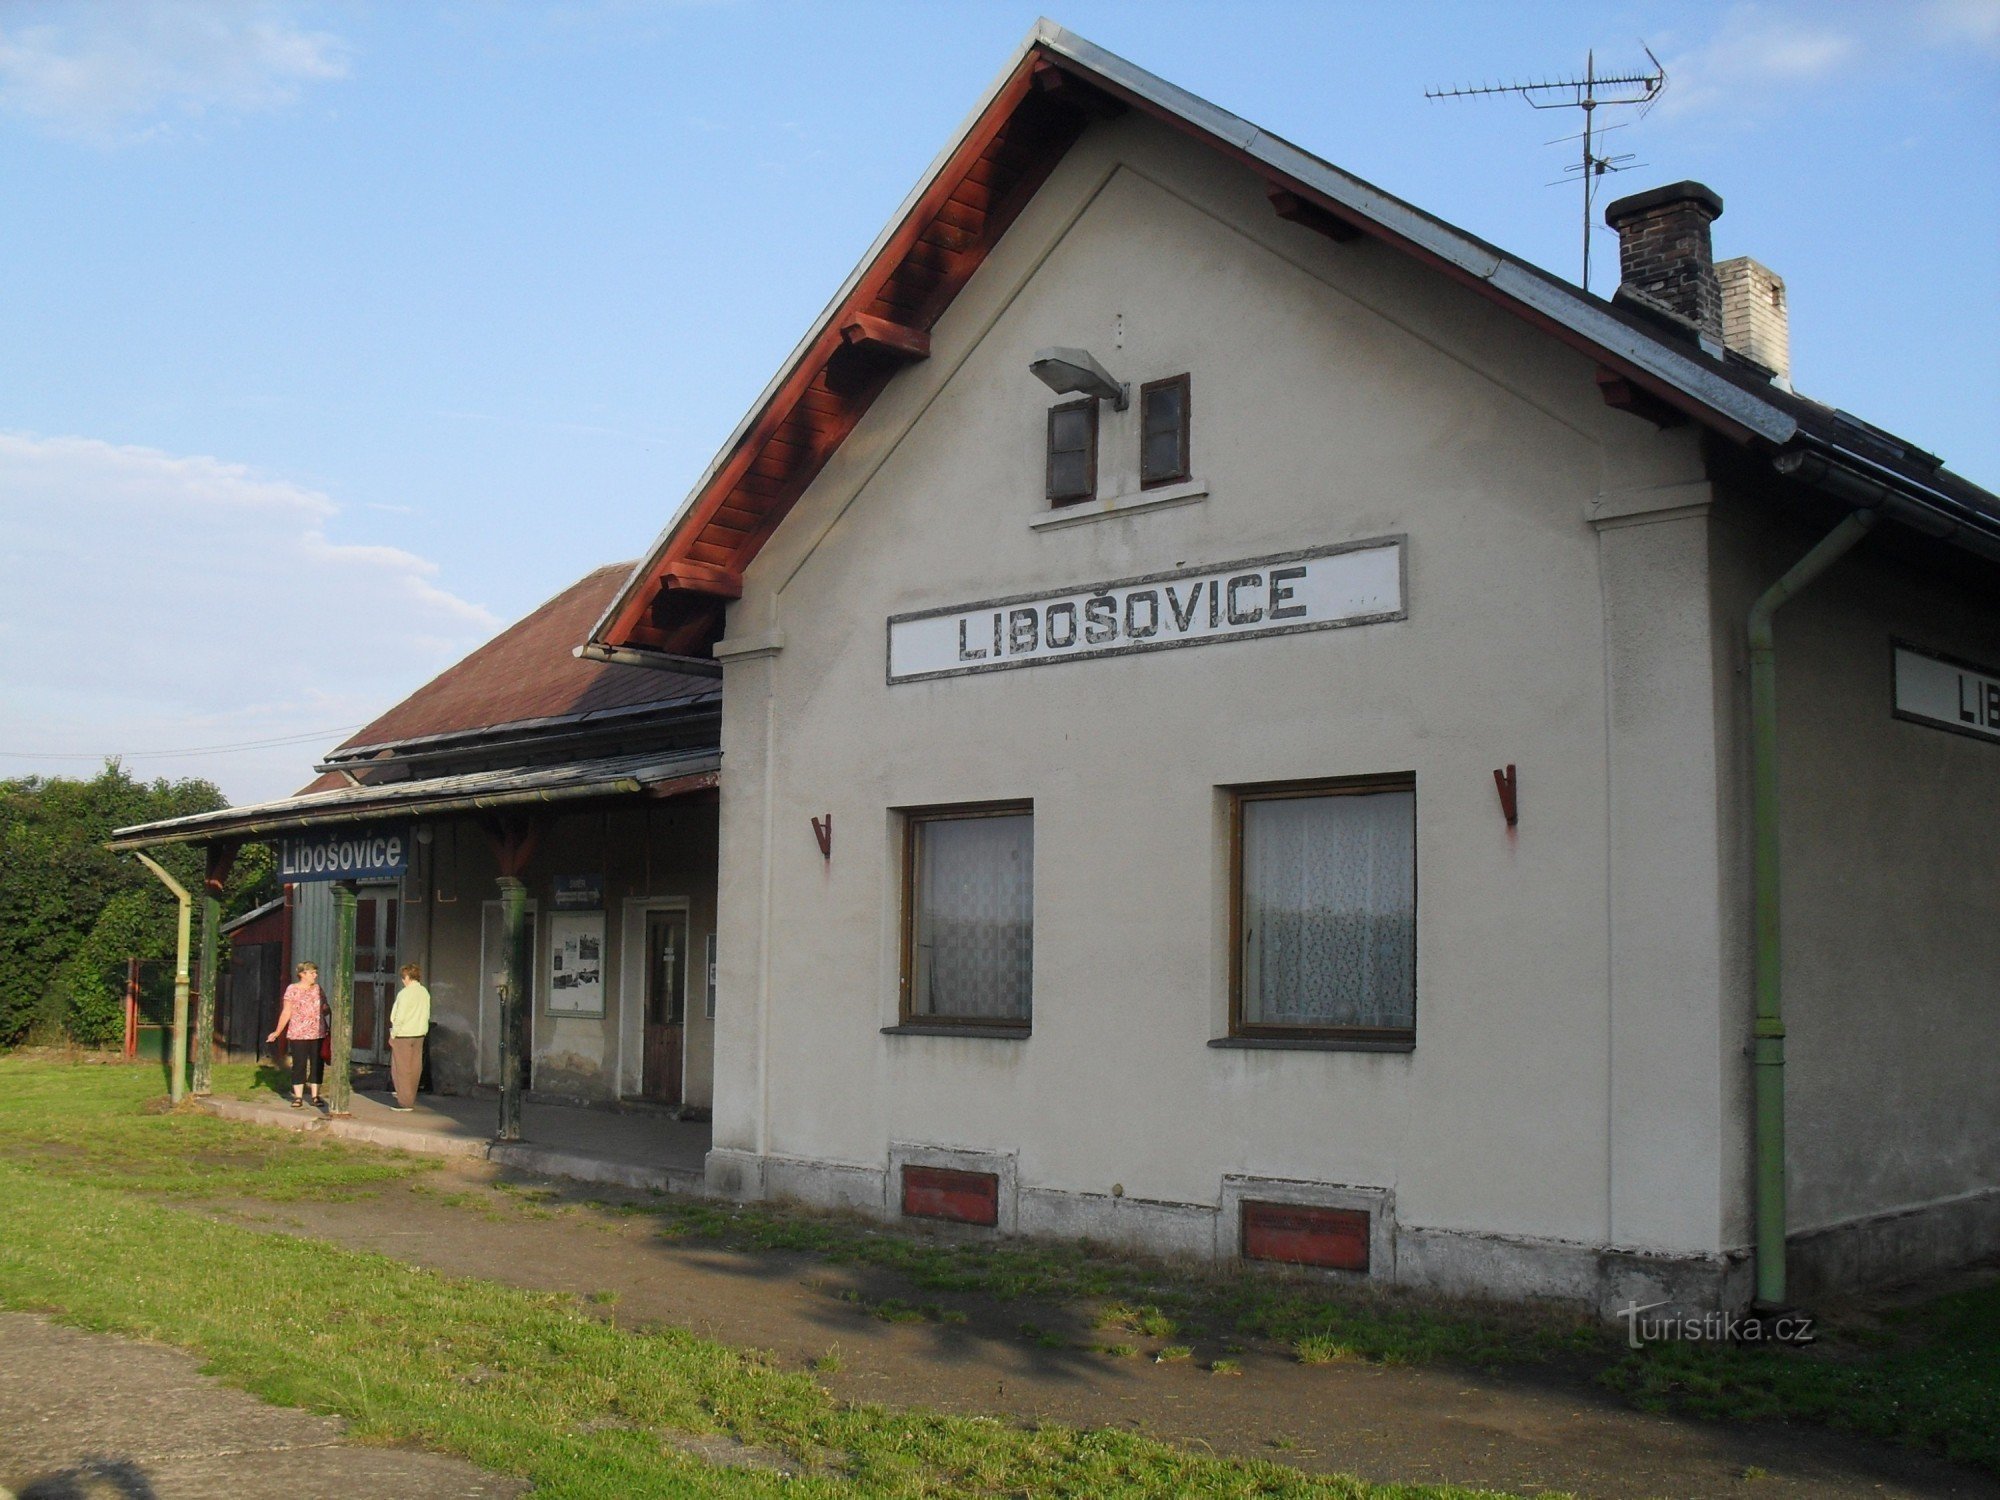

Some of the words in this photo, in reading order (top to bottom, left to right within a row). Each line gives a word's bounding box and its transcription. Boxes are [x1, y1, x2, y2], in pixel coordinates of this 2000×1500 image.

[959, 566, 1307, 661] LIBOŠOVICE
[1959, 674, 2000, 729] LIB
[283, 830, 401, 874] Libošovice
